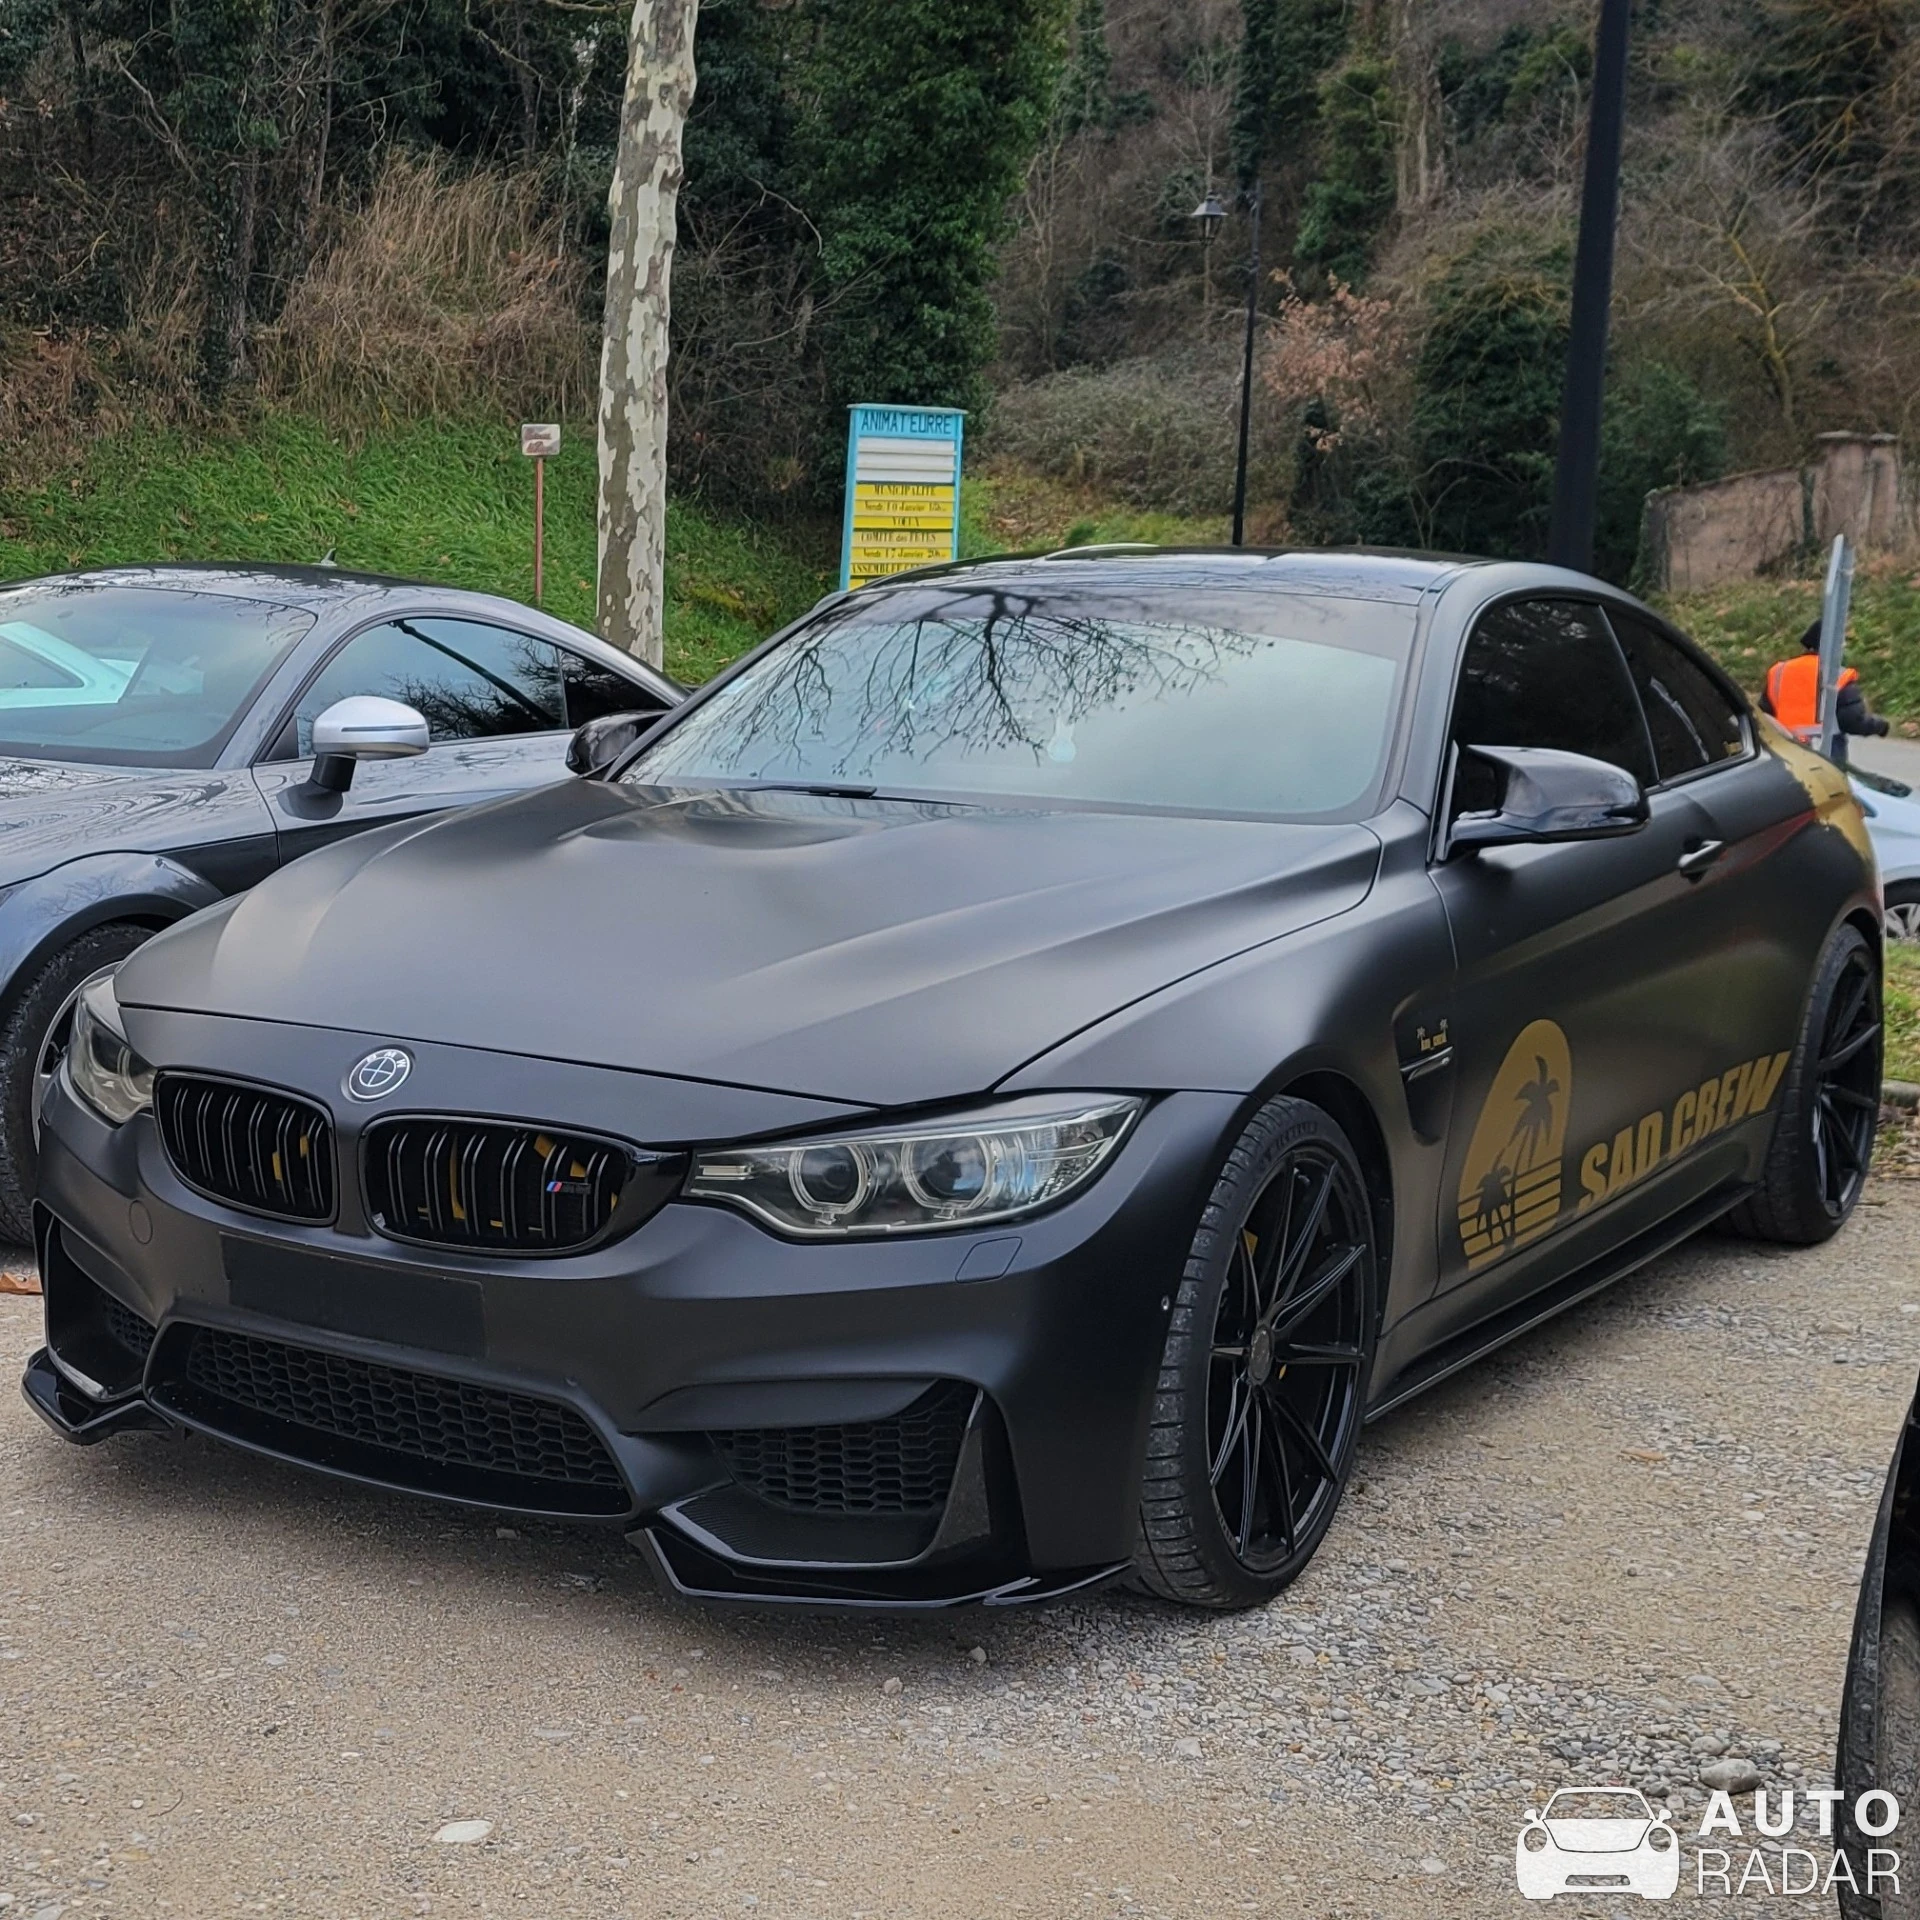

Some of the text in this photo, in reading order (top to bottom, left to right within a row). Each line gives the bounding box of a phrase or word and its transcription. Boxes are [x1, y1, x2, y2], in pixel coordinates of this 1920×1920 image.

[366, 1051, 407, 1068] BMW
[1573, 1050, 1792, 1217] SAD CREW
